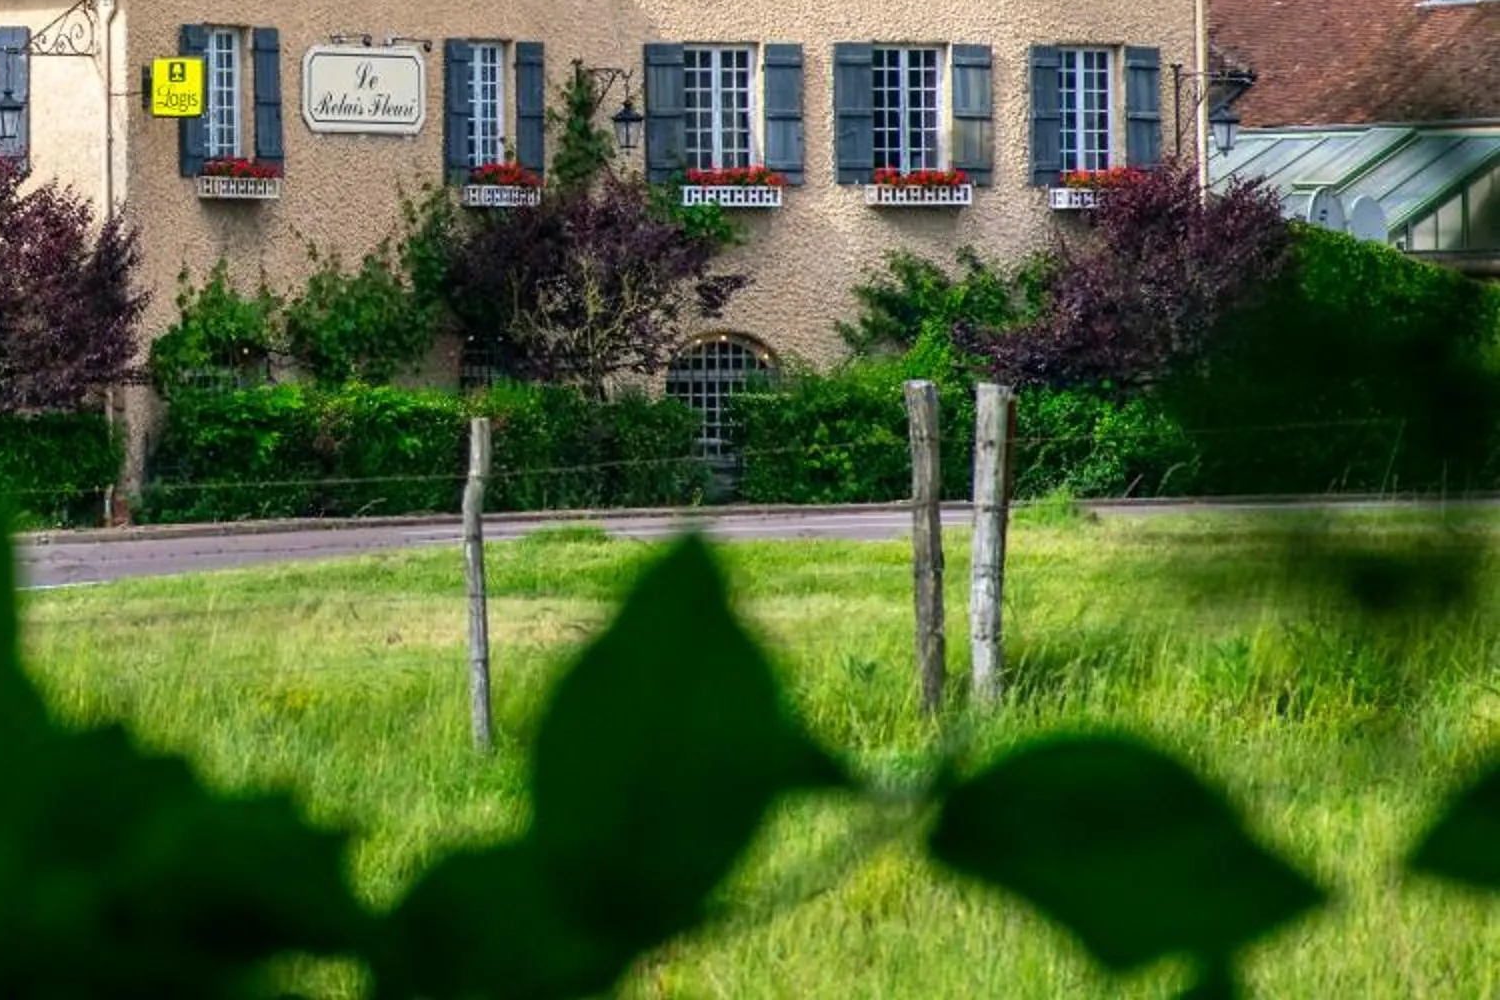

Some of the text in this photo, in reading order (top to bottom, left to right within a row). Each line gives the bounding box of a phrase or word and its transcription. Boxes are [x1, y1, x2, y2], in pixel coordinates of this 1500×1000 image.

[355, 61, 379, 90] Le
[156, 86, 199, 112] Logis
[314, 91, 416, 117] Relais Fleuri
